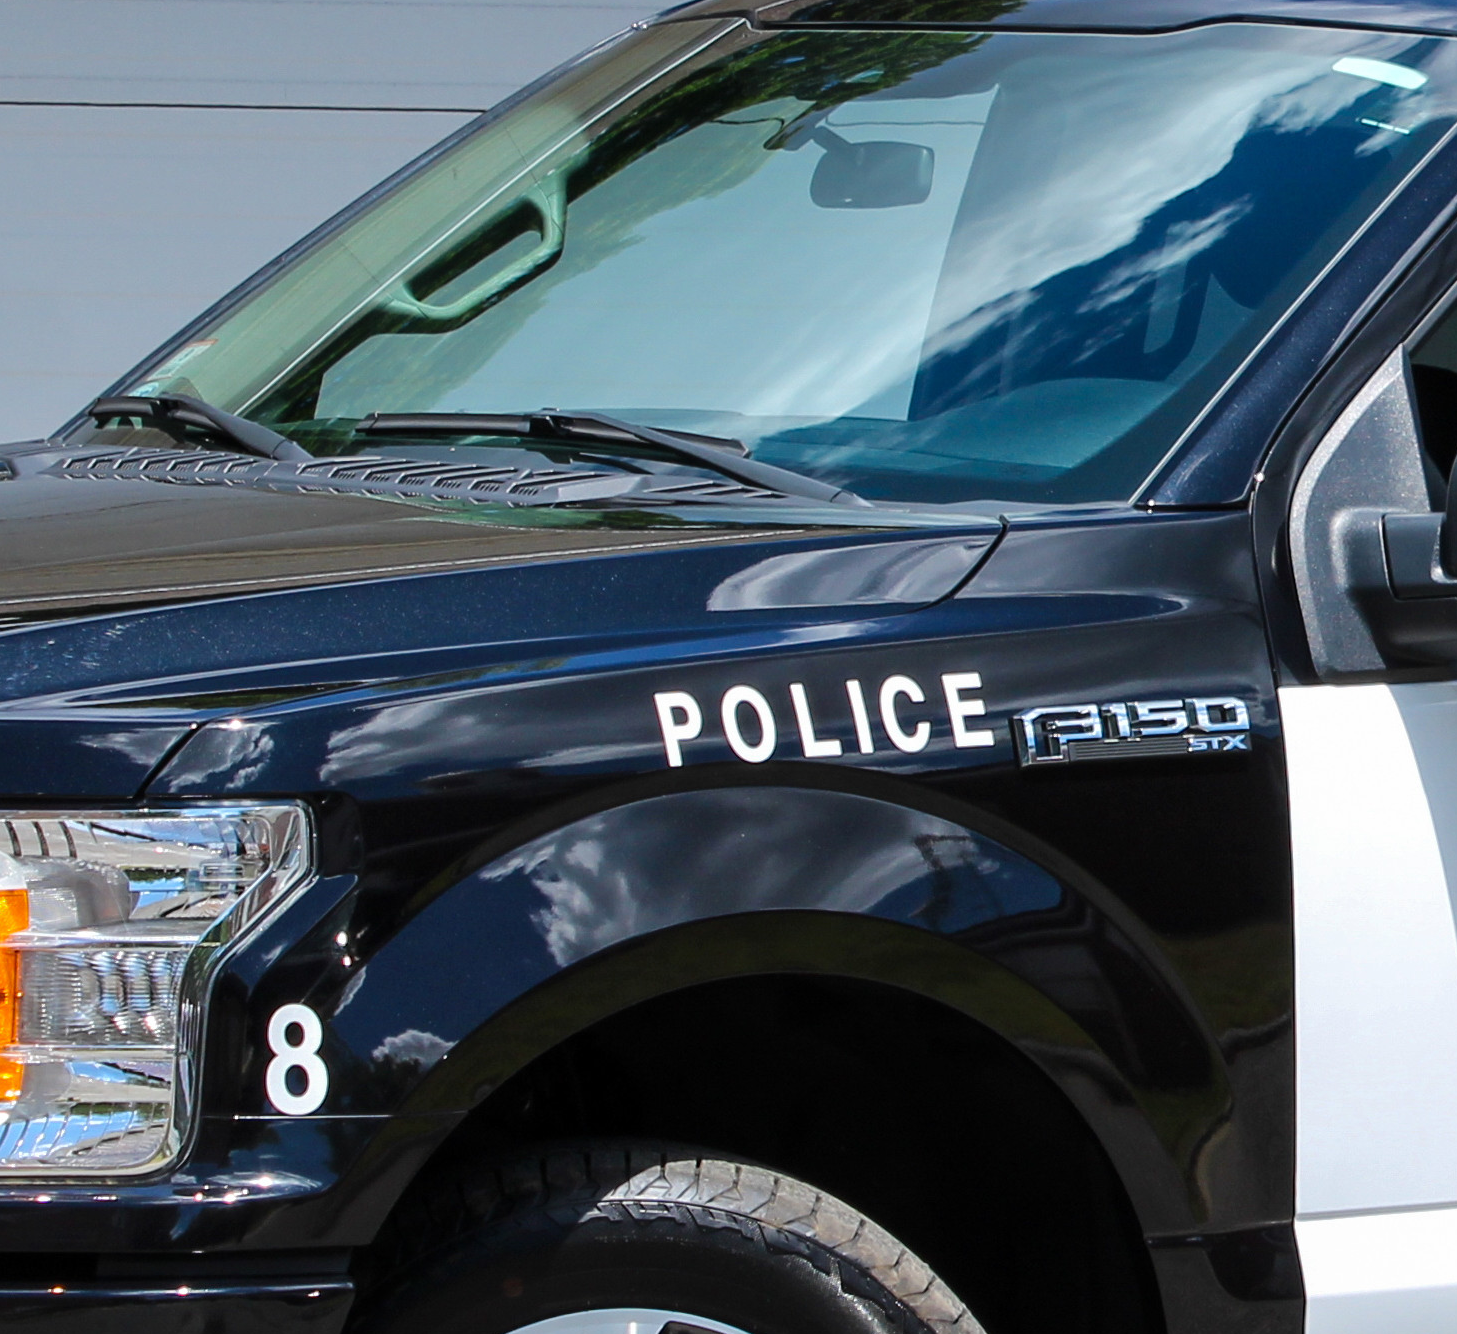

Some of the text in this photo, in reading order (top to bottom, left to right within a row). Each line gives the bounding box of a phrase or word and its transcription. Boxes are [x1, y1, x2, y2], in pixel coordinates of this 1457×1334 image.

[653, 671, 996, 768] POLICE
[1188, 734, 1248, 752] STX
[264, 1002, 330, 1116] 8
